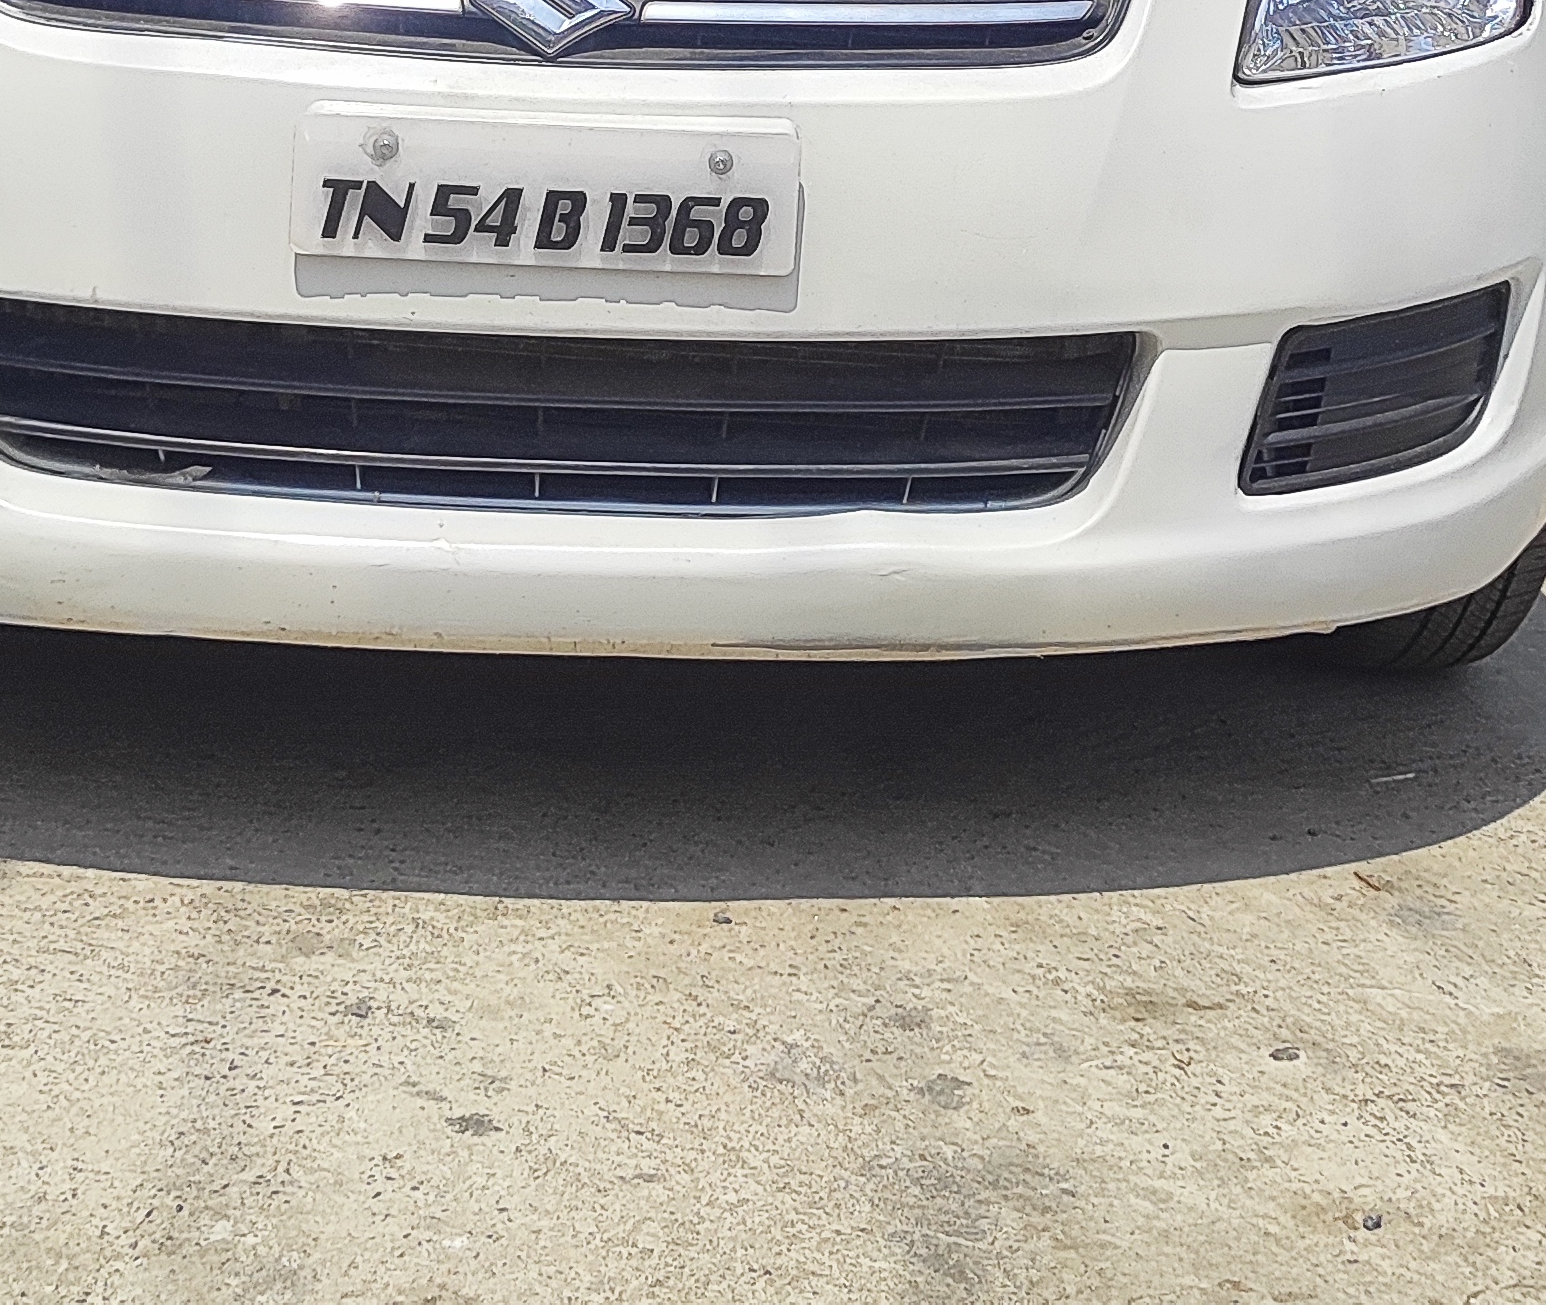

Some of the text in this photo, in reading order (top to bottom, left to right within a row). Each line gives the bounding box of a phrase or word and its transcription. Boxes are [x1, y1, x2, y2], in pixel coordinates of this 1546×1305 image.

[320, 177, 770, 257] TN 54 B 1368
